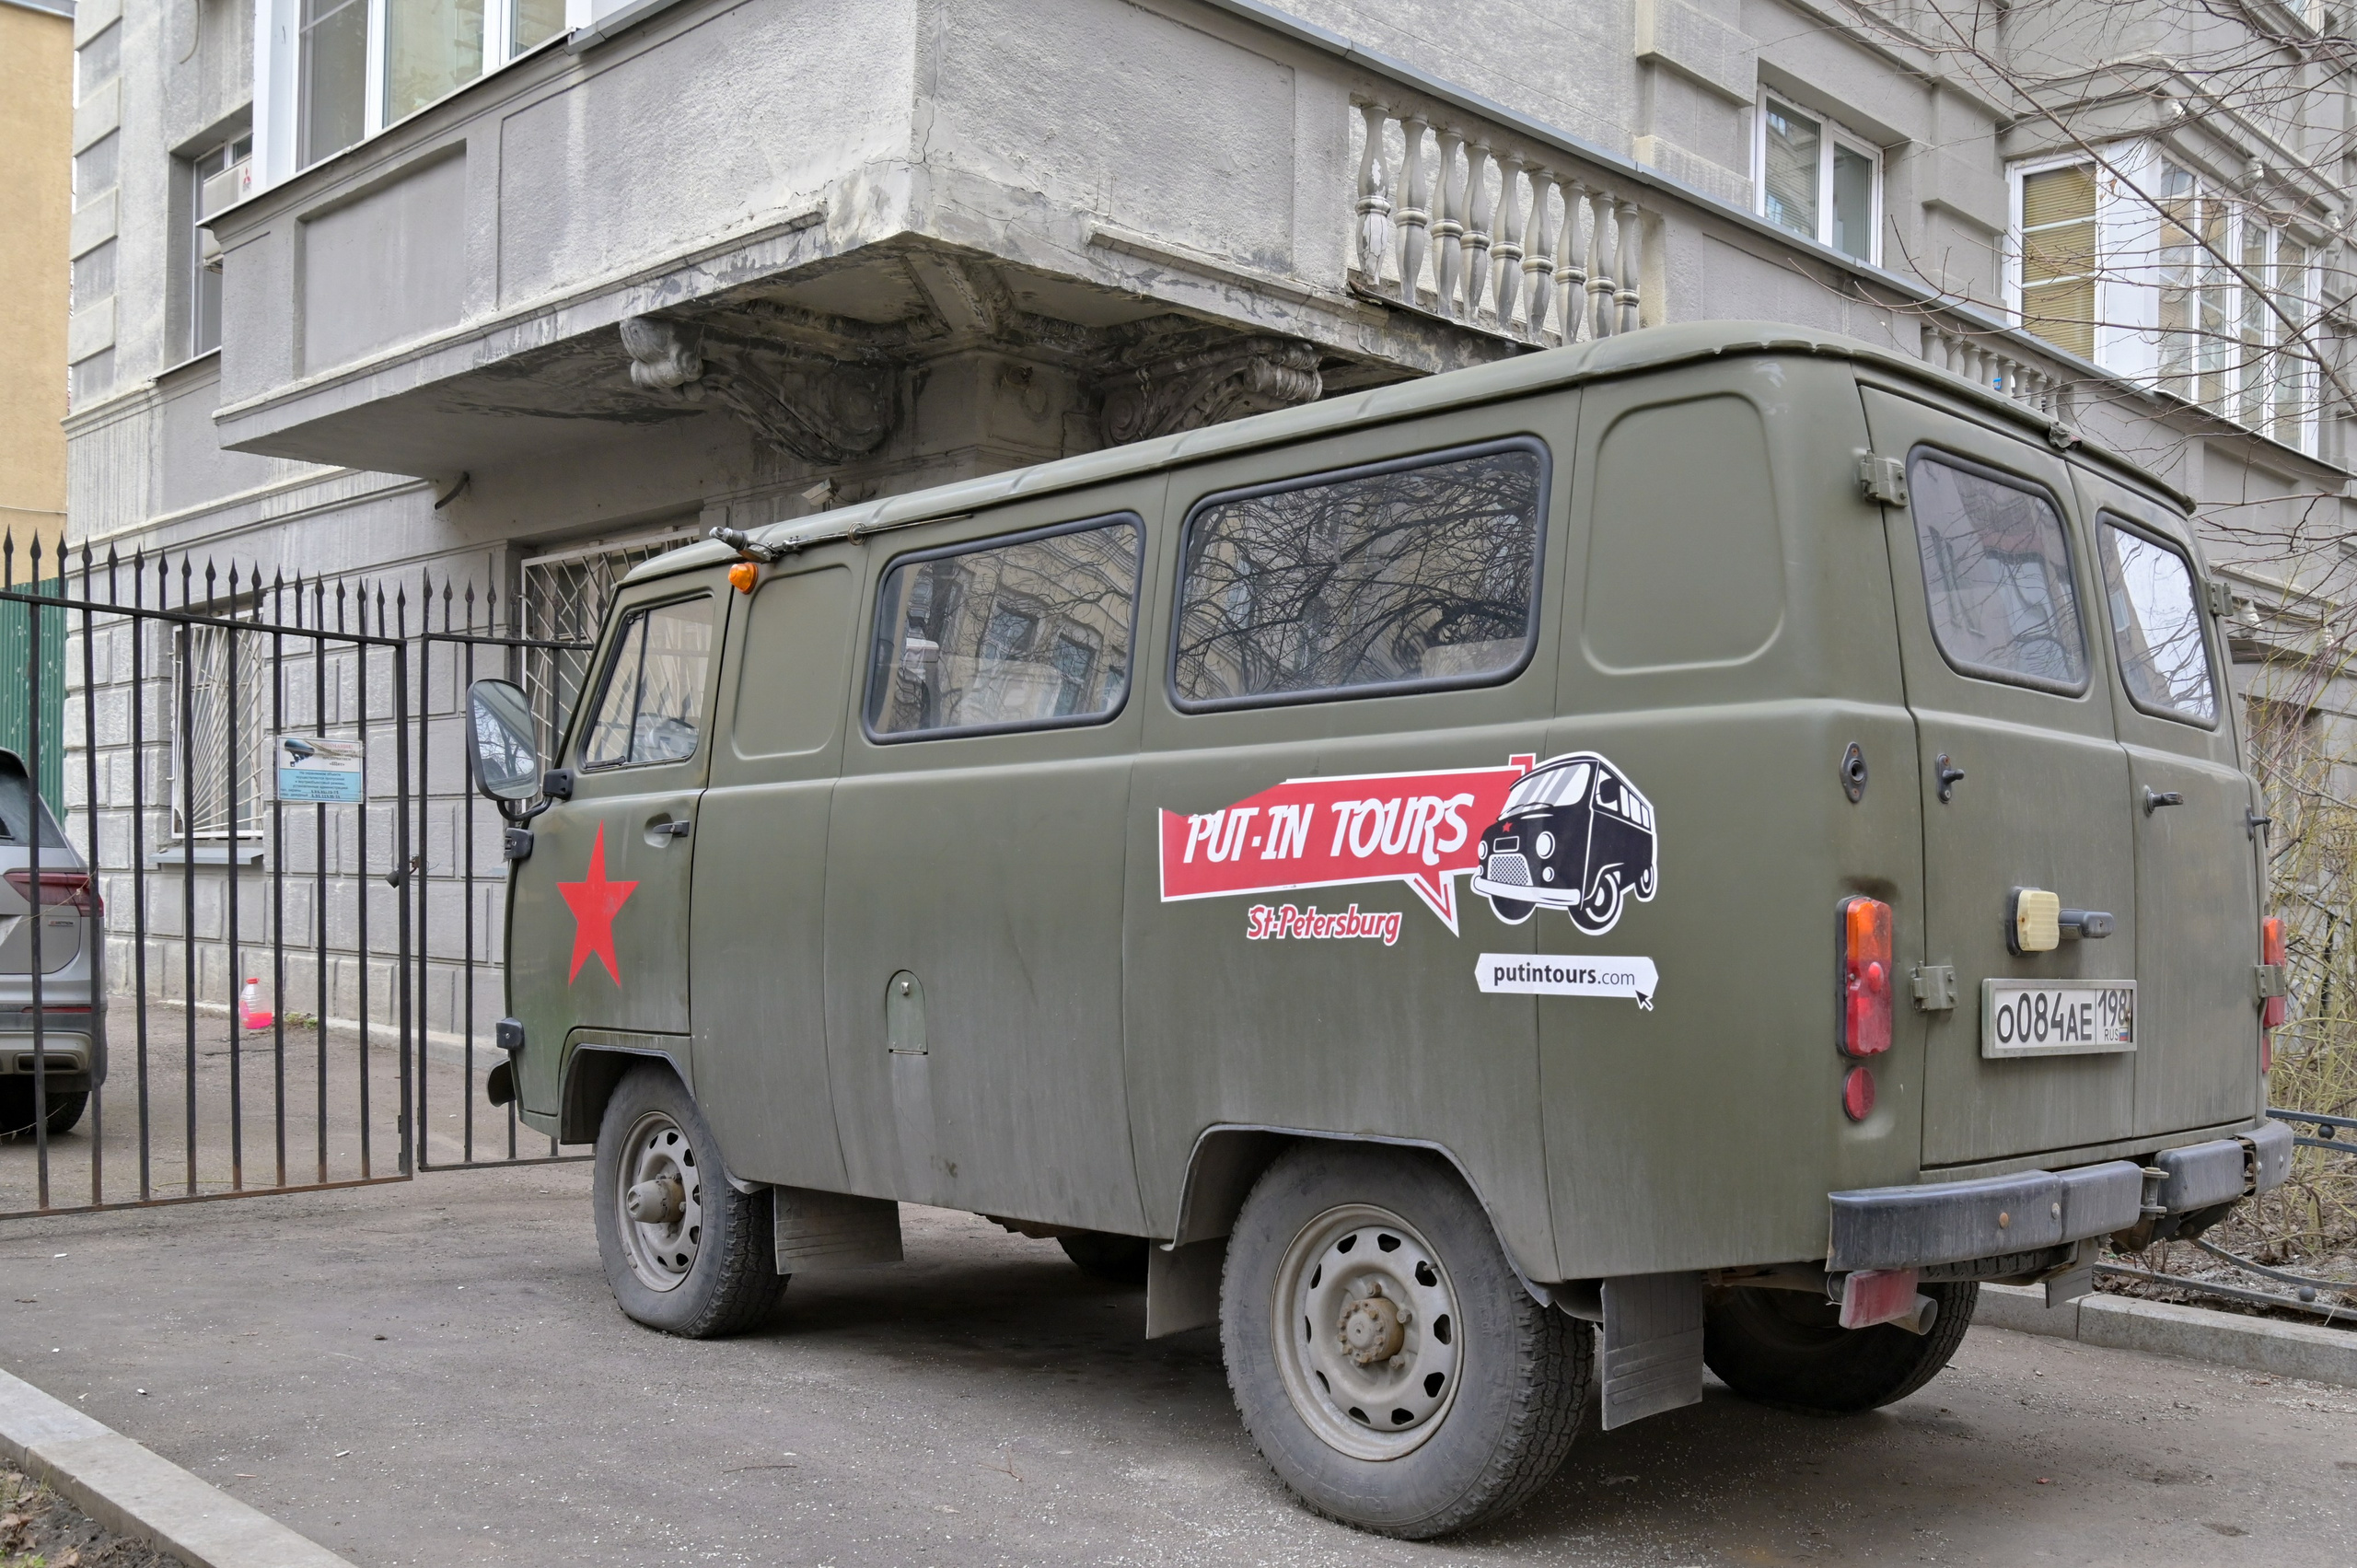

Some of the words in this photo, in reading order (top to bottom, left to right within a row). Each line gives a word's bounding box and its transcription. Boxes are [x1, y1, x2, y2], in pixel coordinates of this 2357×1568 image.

[1330, 793, 1475, 865] TOURS
[1247, 904, 1401, 946] St-Petersburg
[1494, 962, 1635, 986] putintours.com
[2097, 989, 2128, 1028] 198
[2104, 1028, 2119, 1041] RUS
